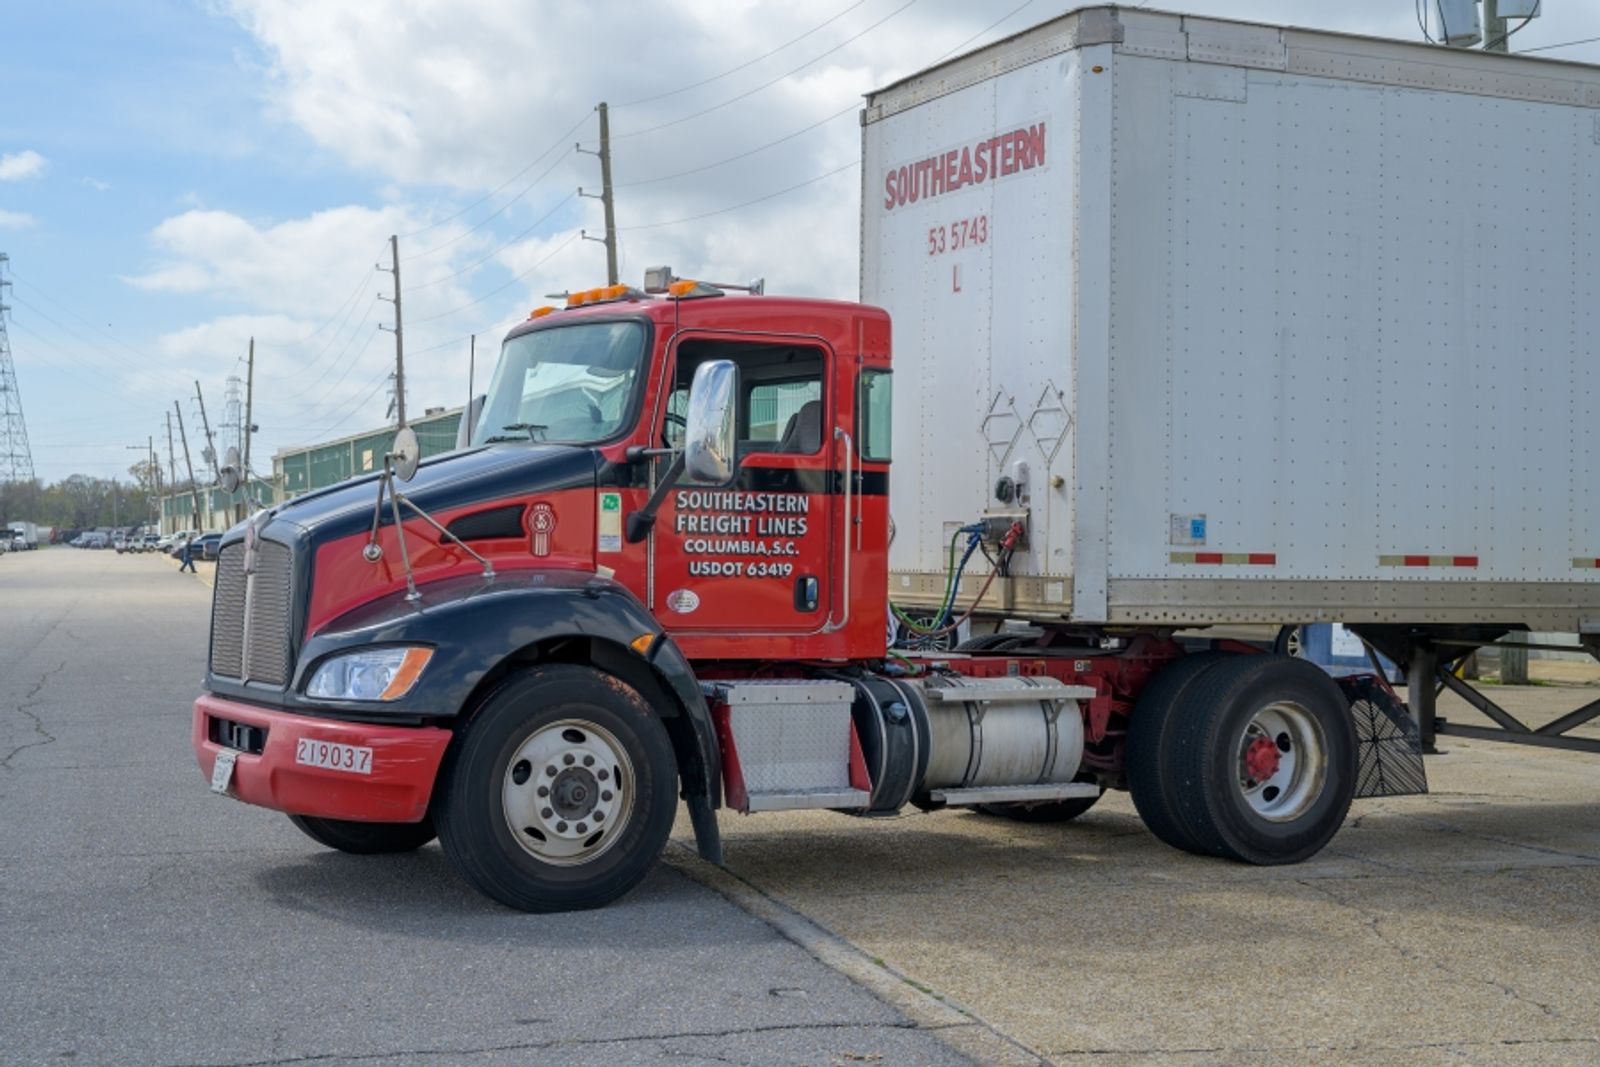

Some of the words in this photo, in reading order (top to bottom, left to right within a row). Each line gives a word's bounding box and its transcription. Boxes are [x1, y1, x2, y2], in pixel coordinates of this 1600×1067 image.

[884, 122, 1046, 210] SOUTHEASTERN
[928, 226, 946, 255] 53
[951, 215, 988, 250] 5743
[952, 265, 961, 293] L
[677, 490, 809, 512] SOUTHEASTERN
[677, 514, 752, 533] FREIGHT
[757, 517, 808, 535] LINES
[690, 561, 743, 575] USDOT
[747, 563, 793, 576] 63419
[299, 741, 369, 770] 219037
